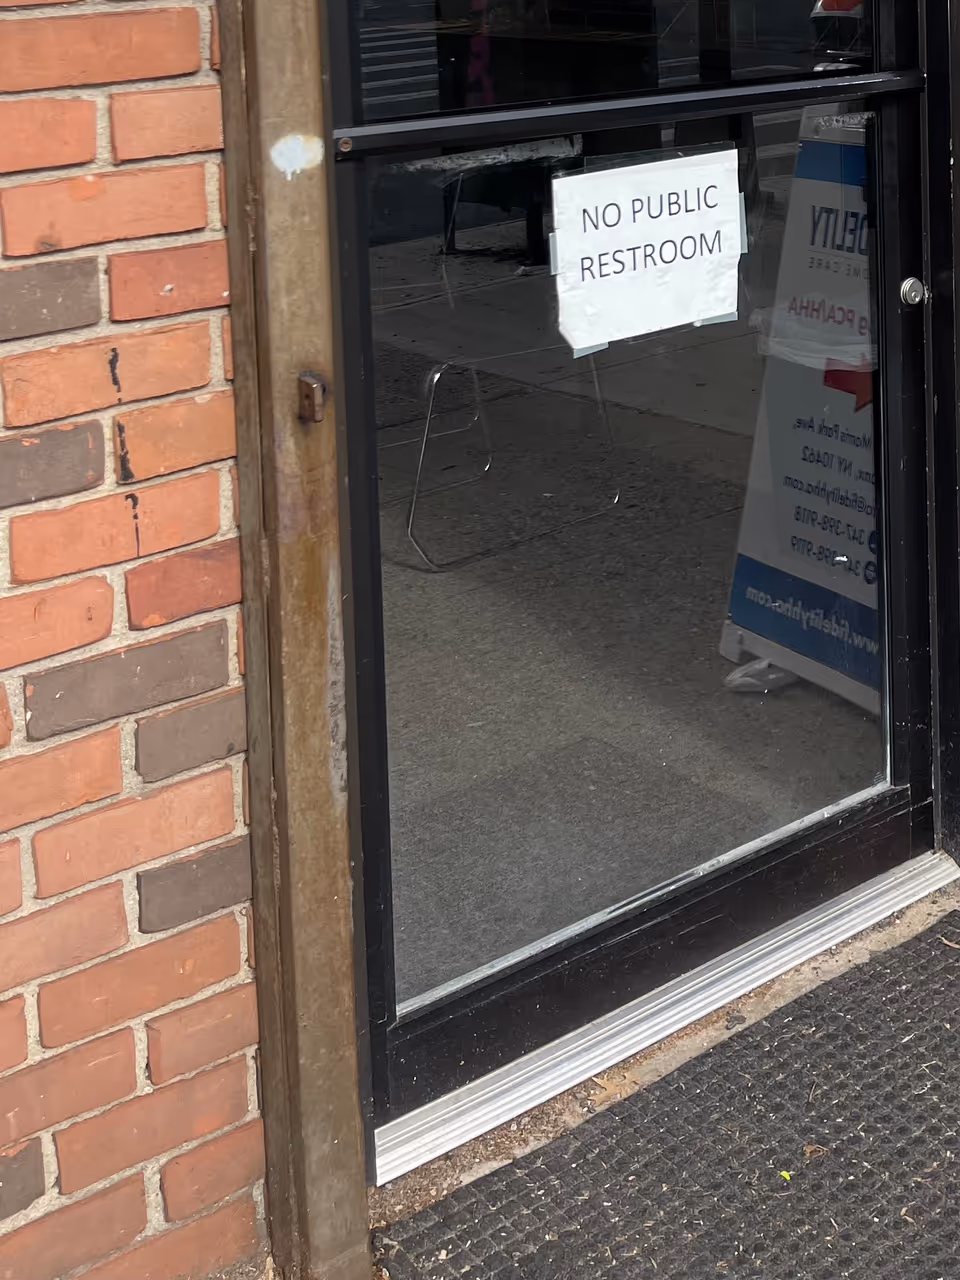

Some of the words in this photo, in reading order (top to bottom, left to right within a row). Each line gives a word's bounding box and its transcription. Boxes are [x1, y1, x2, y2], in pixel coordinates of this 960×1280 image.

[582, 202, 621, 233] NO
[632, 185, 719, 224] PUBLIC
[580, 230, 723, 282] RESTROOM
